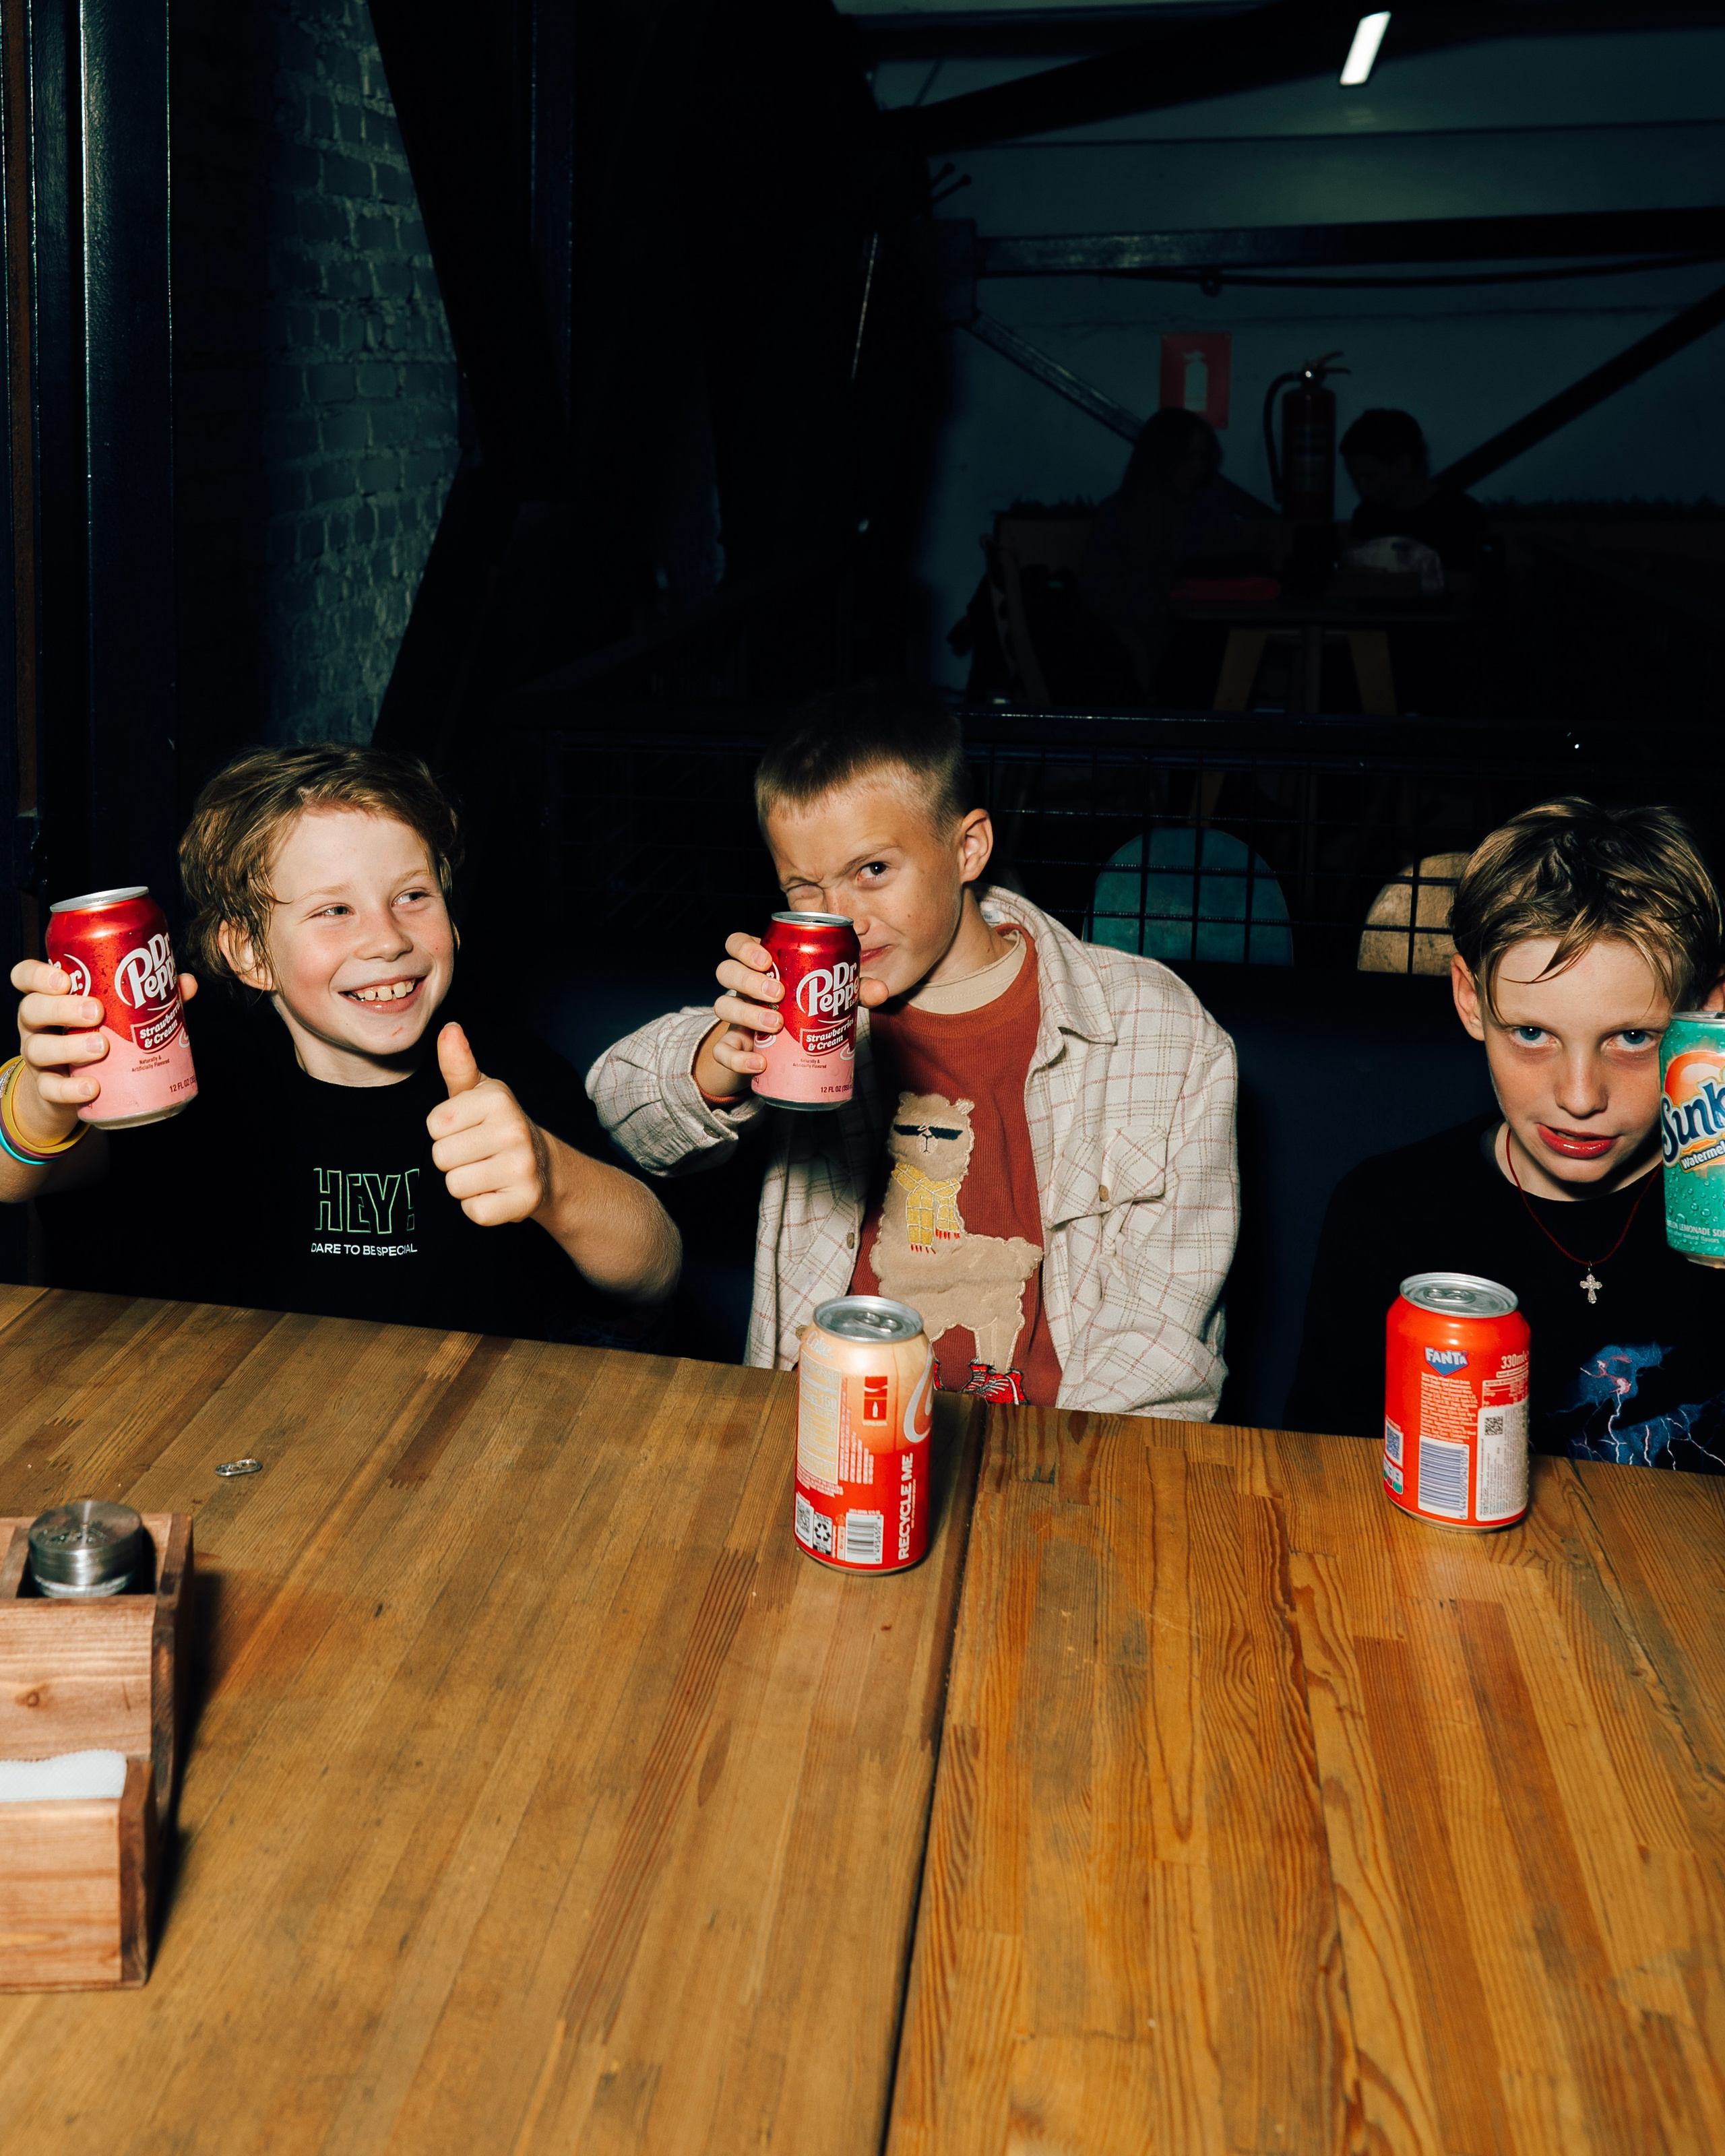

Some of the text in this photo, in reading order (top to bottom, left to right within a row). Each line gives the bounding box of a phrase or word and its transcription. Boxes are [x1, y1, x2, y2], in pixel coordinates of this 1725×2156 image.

[148, 932, 170, 971] Dr
[115, 948, 175, 1009] Pepp
[833, 961, 856, 992] Dr
[796, 969, 859, 1017] Peppe
[144, 1019, 178, 1048] & Cream
[808, 1035, 844, 1051] & Cream
[169, 1084, 177, 1093] 12
[177, 1082, 184, 1091] FL
[1662, 1082, 1725, 1163] Sunk
[1681, 1139, 1725, 1170] Watermel
[313, 1168, 420, 1234] HEY!
[1679, 1223, 1711, 1236] LEMONADE
[1712, 1228, 1725, 1238] SOD
[311, 1242, 342, 1254] DARE
[343, 1244, 360, 1255] TO
[1425, 1348, 1468, 1365] FANTA
[898, 1453, 913, 1560] RECYCLE ME
